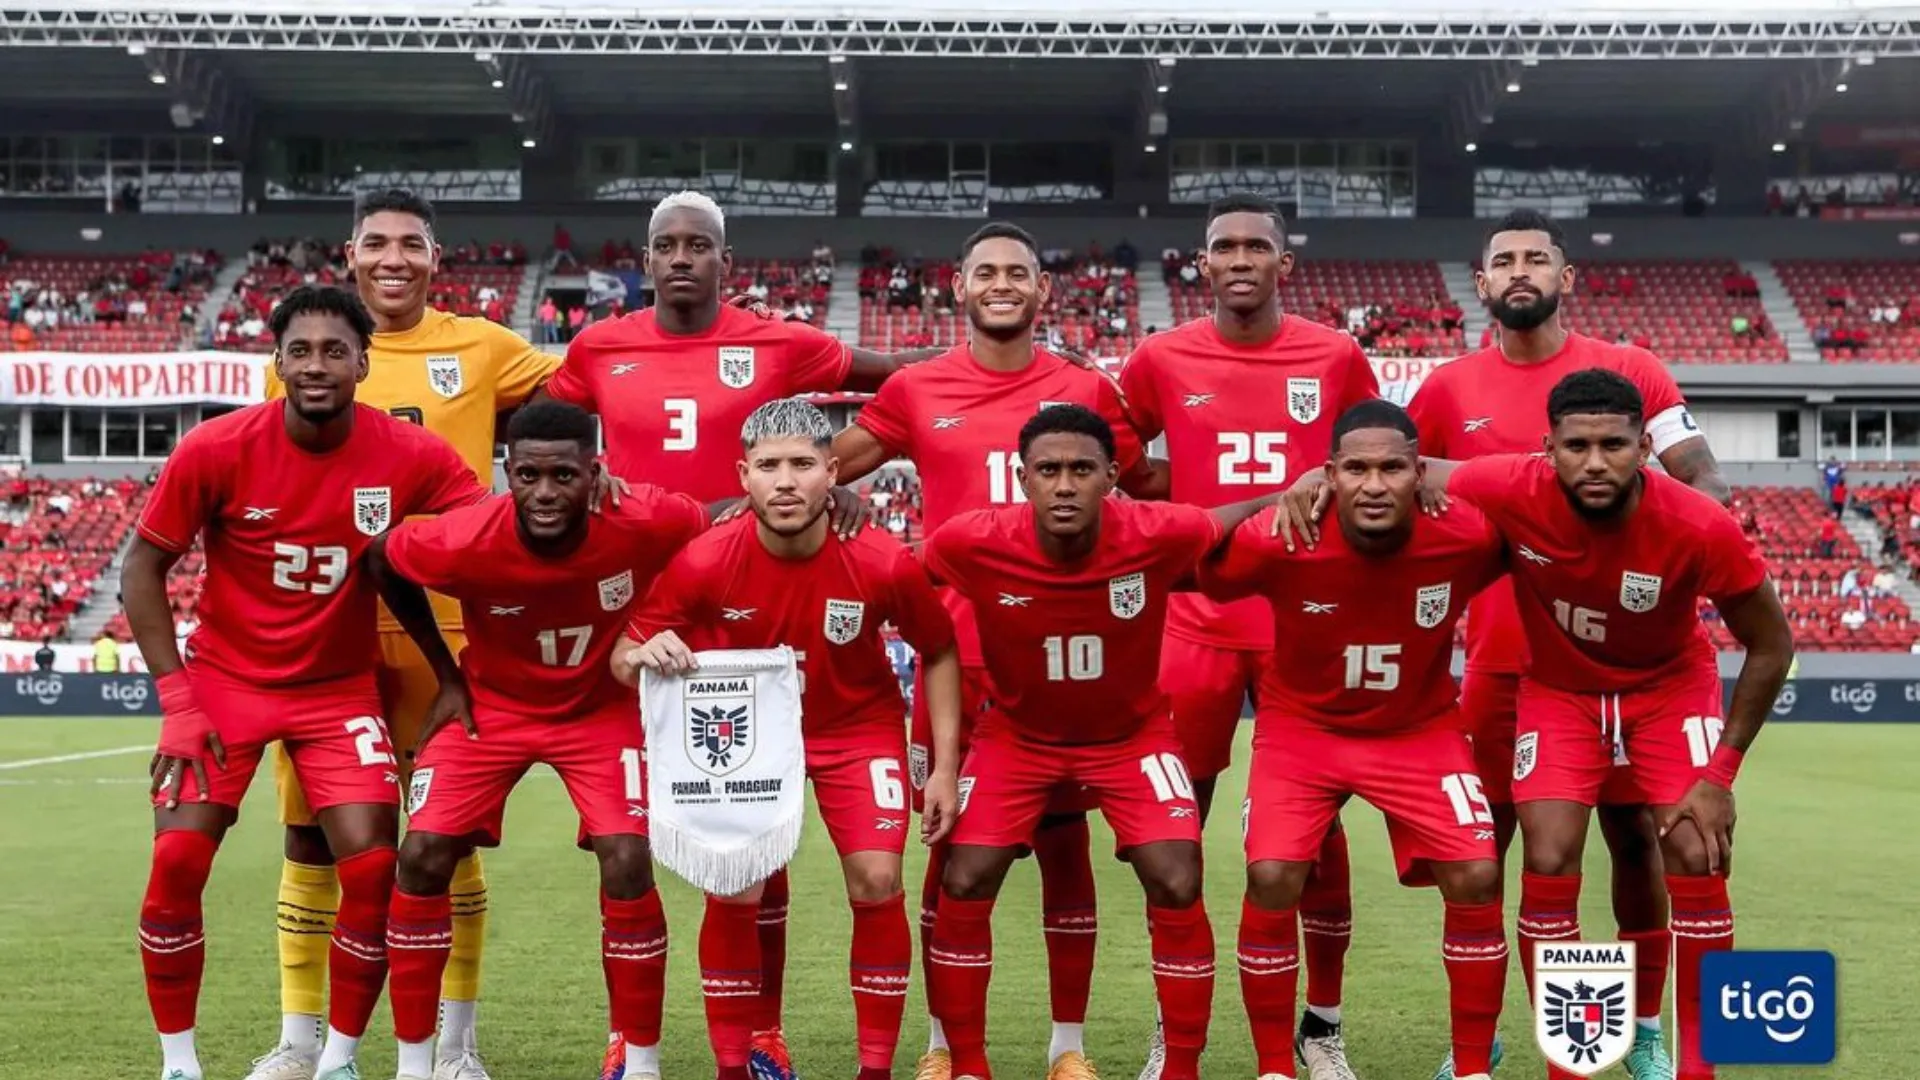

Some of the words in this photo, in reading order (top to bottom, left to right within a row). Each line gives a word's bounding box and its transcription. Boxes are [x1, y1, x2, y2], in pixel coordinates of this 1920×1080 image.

[13, 363, 54, 396] DE
[65, 361, 250, 397] COMPARTIR
[663, 399, 697, 451] 3
[1217, 431, 1288, 485] 25
[272, 541, 349, 595] 23
[1553, 599, 1607, 643] 16
[537, 625, 593, 667] 17
[1042, 635, 1103, 681] 10
[1342, 644, 1402, 691] 15
[690, 680, 749, 694] PANAMÁ
[1905, 683, 1920, 702] ti
[344, 717, 397, 766] 2
[671, 778, 712, 795] PANAMÁ
[725, 778, 782, 794] PARAGUAY
[870, 758, 904, 810] 6
[1140, 752, 1196, 802] 10
[1441, 773, 1494, 825] 15
